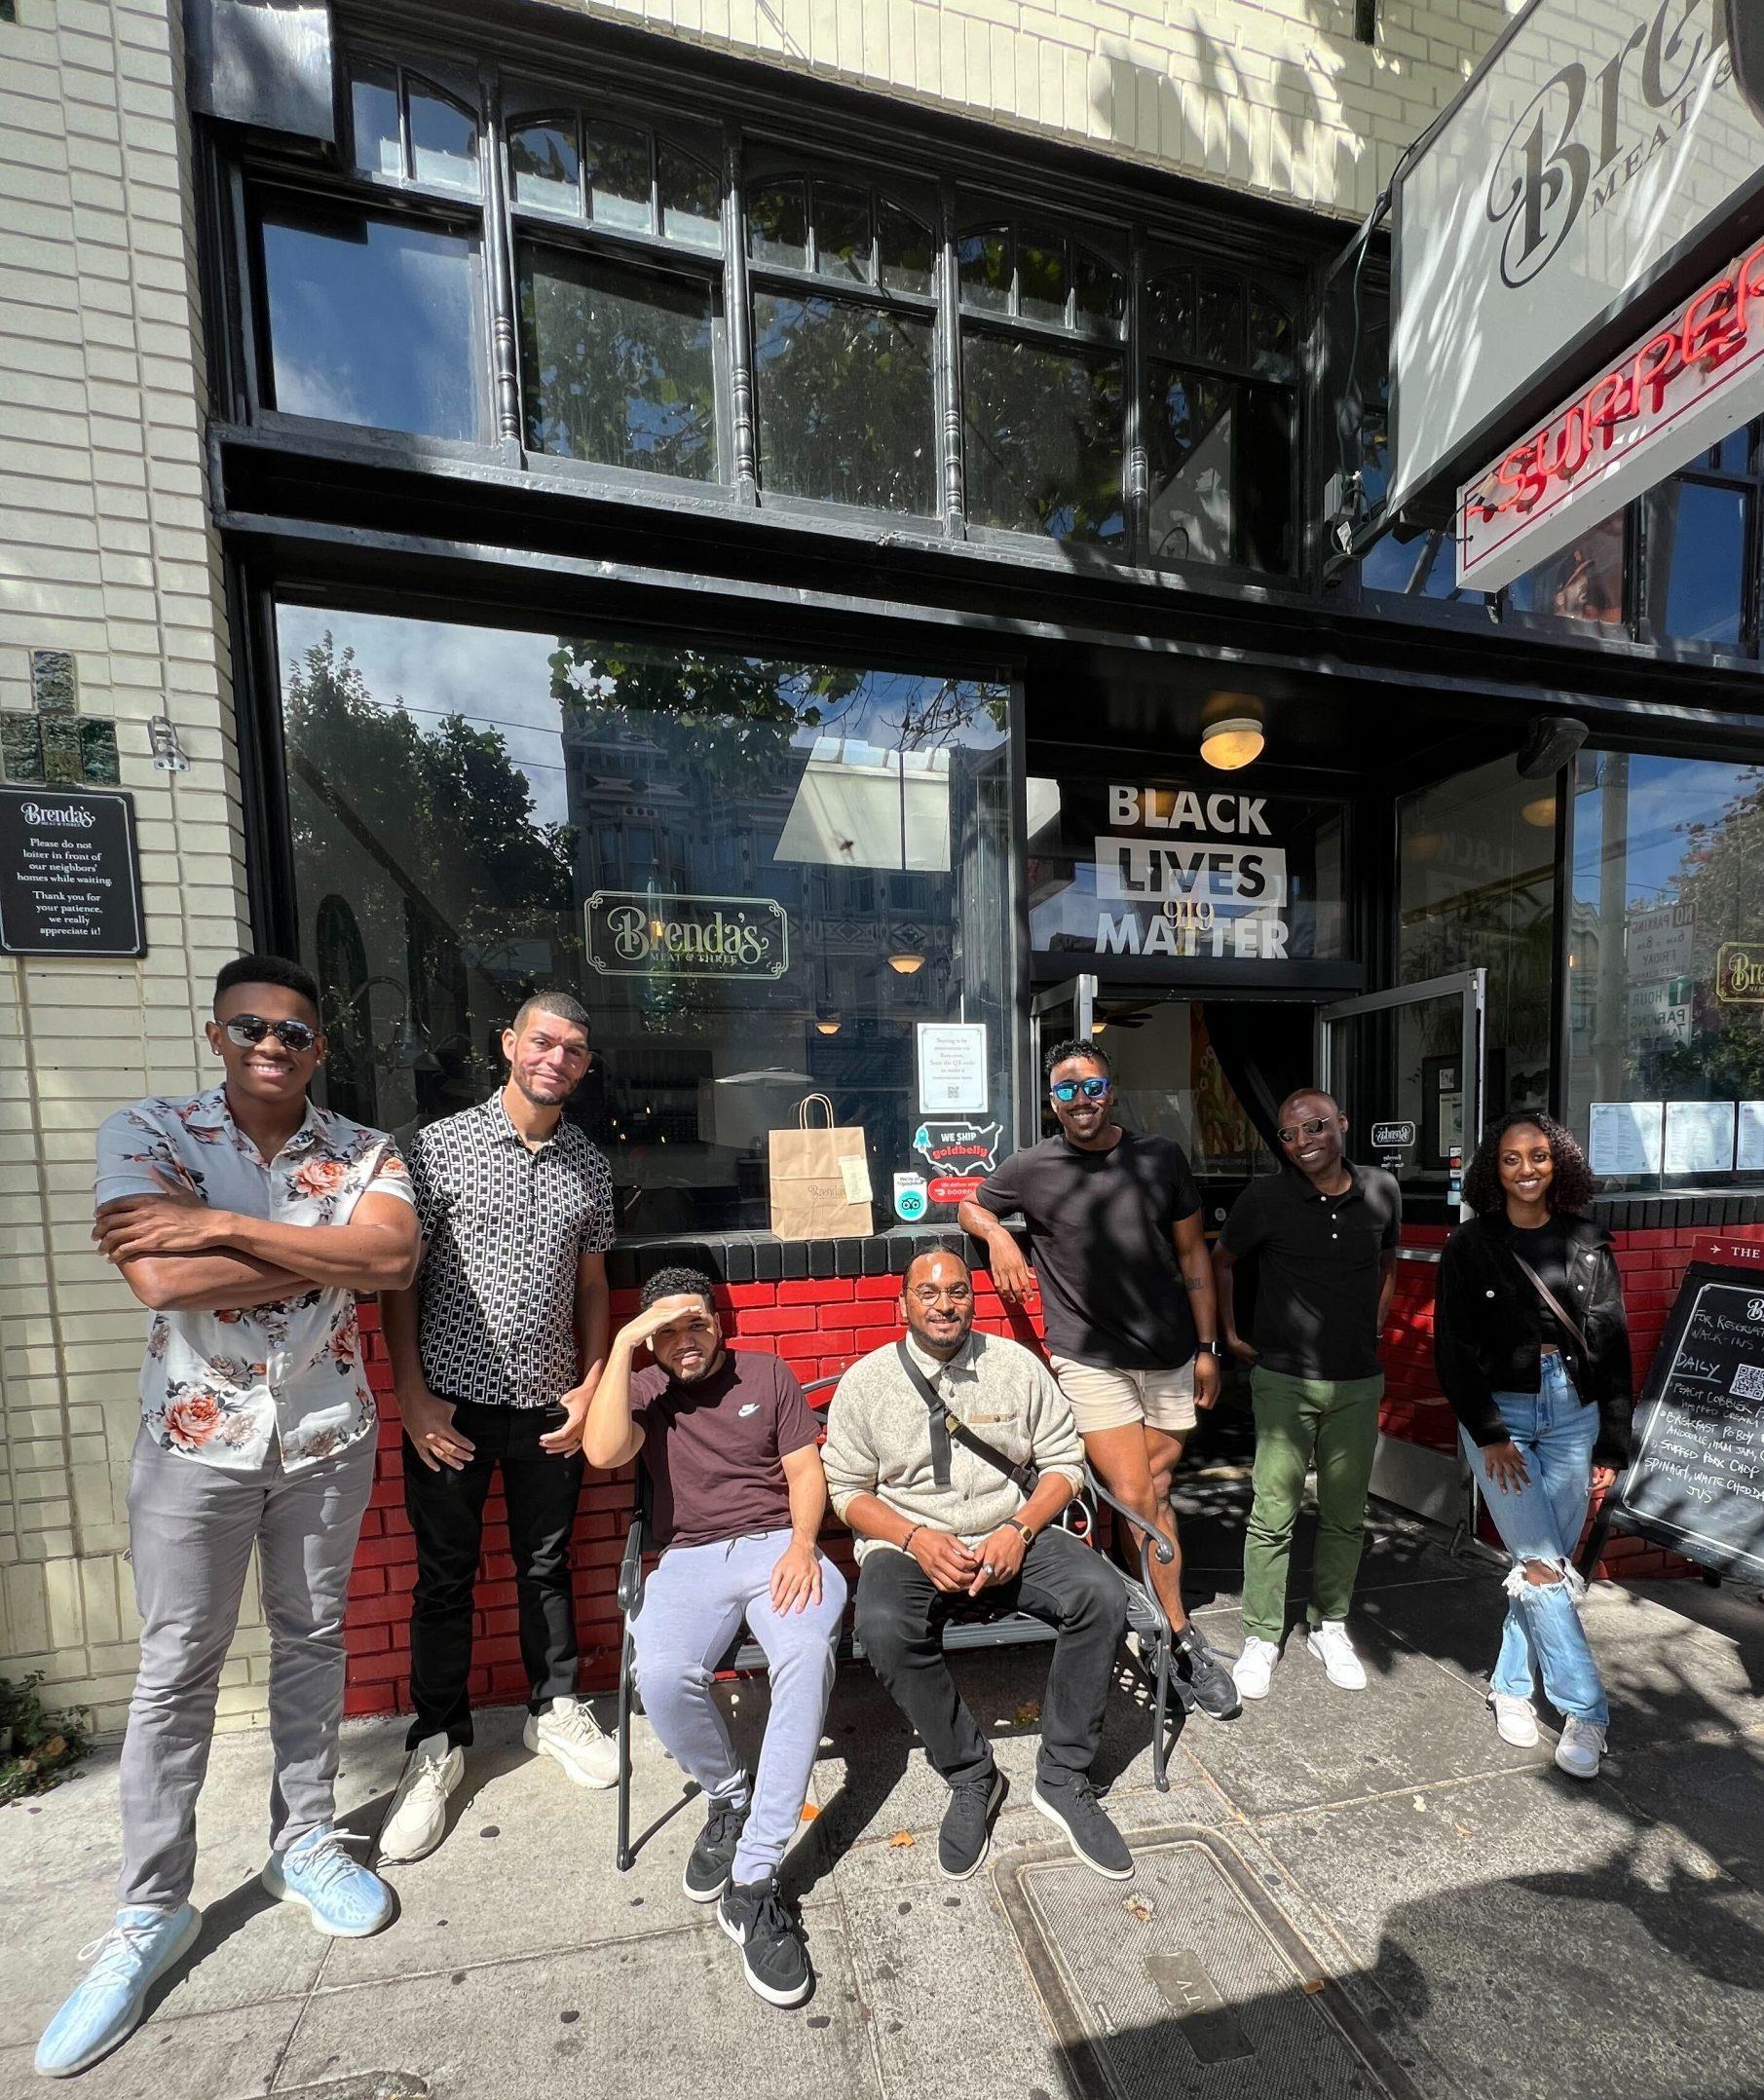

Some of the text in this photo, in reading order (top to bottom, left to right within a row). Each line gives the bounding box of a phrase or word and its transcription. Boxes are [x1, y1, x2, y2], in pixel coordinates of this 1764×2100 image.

[1591, 86, 1697, 218] MEAT
[20, 802, 96, 828] Brenda's
[1108, 784, 1272, 836] BLACK
[29, 838, 59, 847] Please
[61, 840, 74, 849] do
[22, 849, 50, 859] loiter
[52, 851, 62, 860] in
[64, 851, 90, 861] front
[49, 863, 98, 874] neighbors'
[1119, 847, 1266, 898] LIVES
[17, 872, 113, 887] homes while waiting.
[32, 890, 101, 903] Thank you for
[35, 904, 103, 915] your patience,
[1163, 899, 1215, 931] 919
[64, 916, 91, 926] really
[40, 926, 101, 937] appreciate it!
[607, 906, 769, 964] Brenda's
[1095, 913, 1289, 959] MATTER
[941, 1132, 977, 1143] WE SHIP
[932, 1144, 989, 1160] goldbelly
[1731, 1246, 1760, 1258] THE
[1694, 1309, 1713, 1328] FOR
[1676, 1352, 1721, 1378] DAILY
[1707, 1391, 1752, 1414] COBBLER
[1666, 1411, 1718, 1434] BREAKFAST
[1723, 1409, 1758, 1428] CREAM
[1713, 1440, 1732, 1453] HAM
[1660, 1439, 1760, 1480] STUFFED PORK CHOP
[1694, 1471, 1725, 1487] WHITE
[1686, 1485, 1713, 1503] JUS
